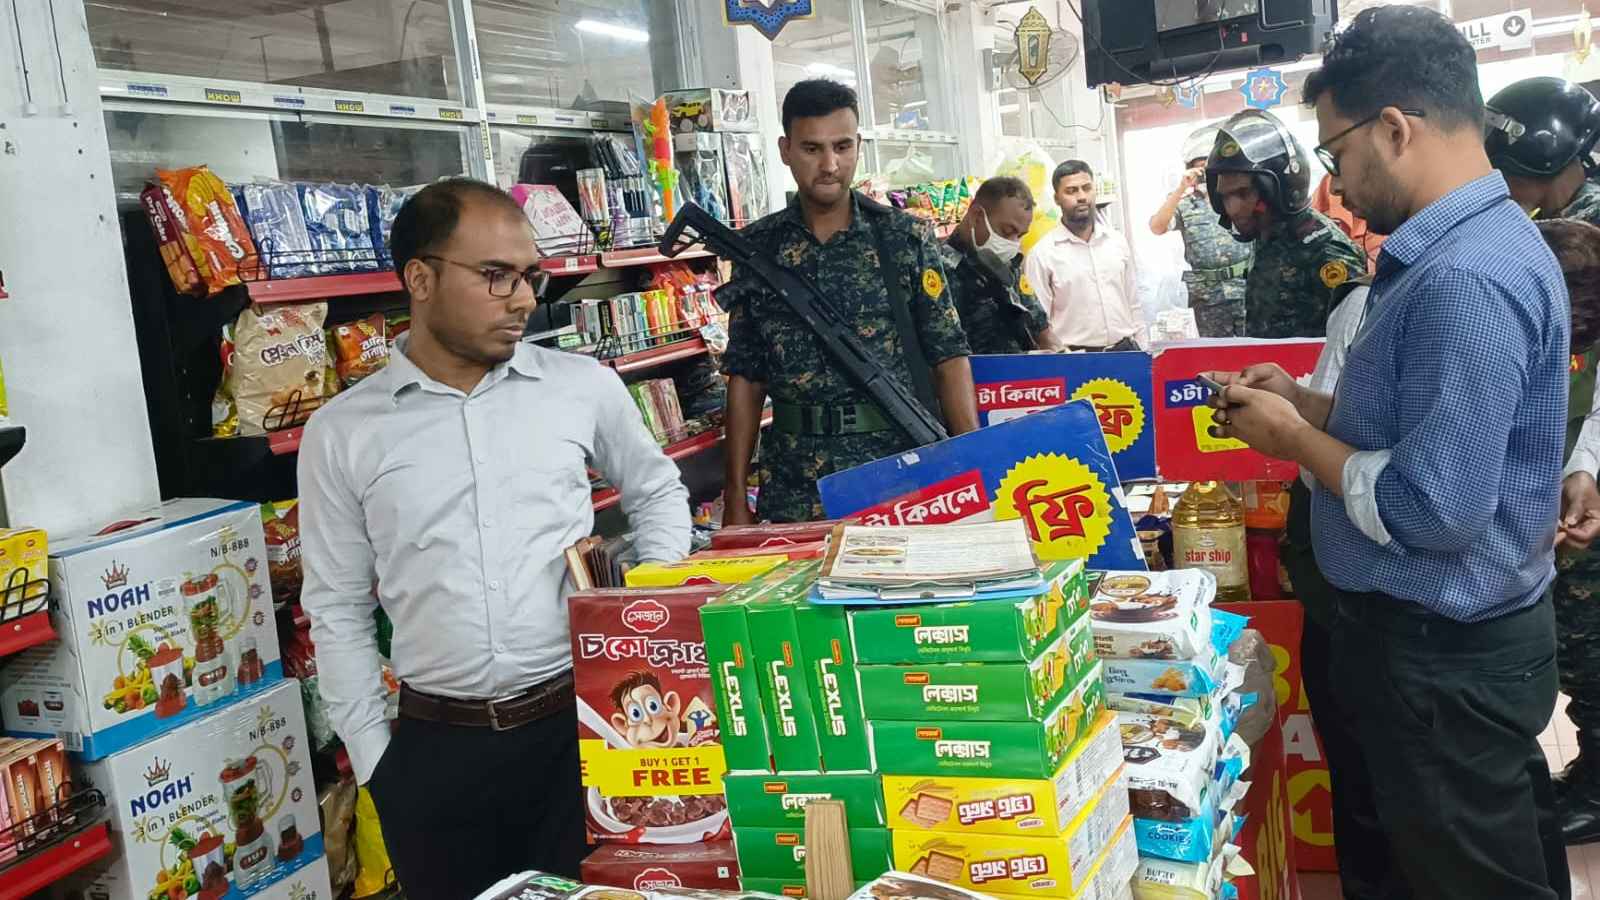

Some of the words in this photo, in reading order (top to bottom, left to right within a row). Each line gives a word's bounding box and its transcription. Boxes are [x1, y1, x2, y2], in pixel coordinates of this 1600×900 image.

[1462, 22, 1491, 39] ILL
[979, 387, 996, 405] টা
[1000, 384, 1061, 403] কিনলে
[1170, 383, 1203, 402] ১টা
[894, 483, 980, 527] কিনলে
[1012, 479, 1096, 543] ফ্রি
[1185, 549, 1206, 563] star
[1208, 549, 1232, 565] ship
[87, 583, 150, 618] NOAH
[105, 624, 117, 636] in
[127, 605, 175, 629] BLENDER
[627, 610, 665, 623] সেজান
[914, 625, 970, 644] লেক্সাস
[579, 633, 648, 661] চকো
[720, 660, 747, 737] LEXUS
[771, 659, 797, 737] LEXUS
[821, 658, 846, 737] LEXUS
[923, 684, 979, 703] লেক্সাস
[935, 740, 992, 758] লেক্সাস
[640, 758, 660, 767] BUY
[672, 757, 691, 766] GET
[632, 768, 711, 787] FREE
[130, 776, 192, 817] NOAH
[147, 820, 158, 833] in
[168, 794, 215, 823] BLENDER
